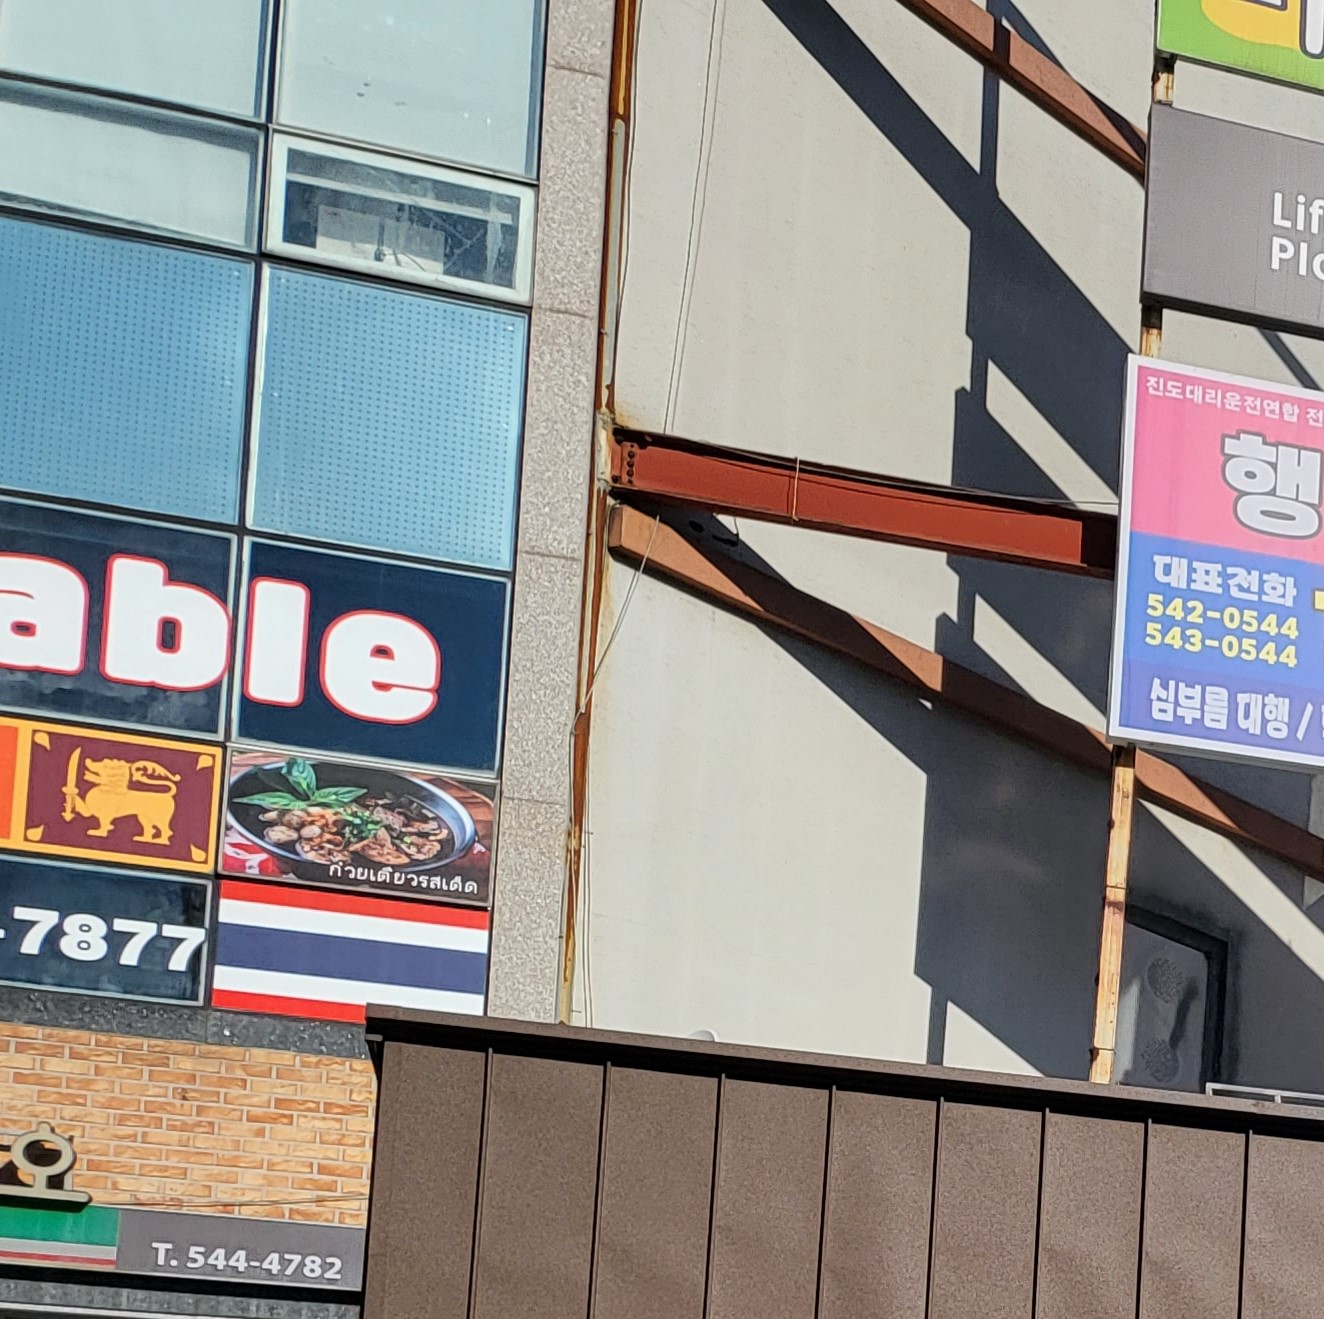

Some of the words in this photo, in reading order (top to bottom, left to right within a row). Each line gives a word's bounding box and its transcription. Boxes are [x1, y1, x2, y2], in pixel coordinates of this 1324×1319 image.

[1145, 375, 1300, 425] 진도대리운전연합
[1152, 553, 1297, 608] 대표전화
[1145, 593, 1299, 640] 542-0544
[1145, 623, 1299, 668] 543-0544
[1150, 678, 1229, 730] 심부름
[1236, 692, 1291, 739] 대행
[0, 906, 206, 972] 7877
[186, 1246, 343, 1280] 544-4782
